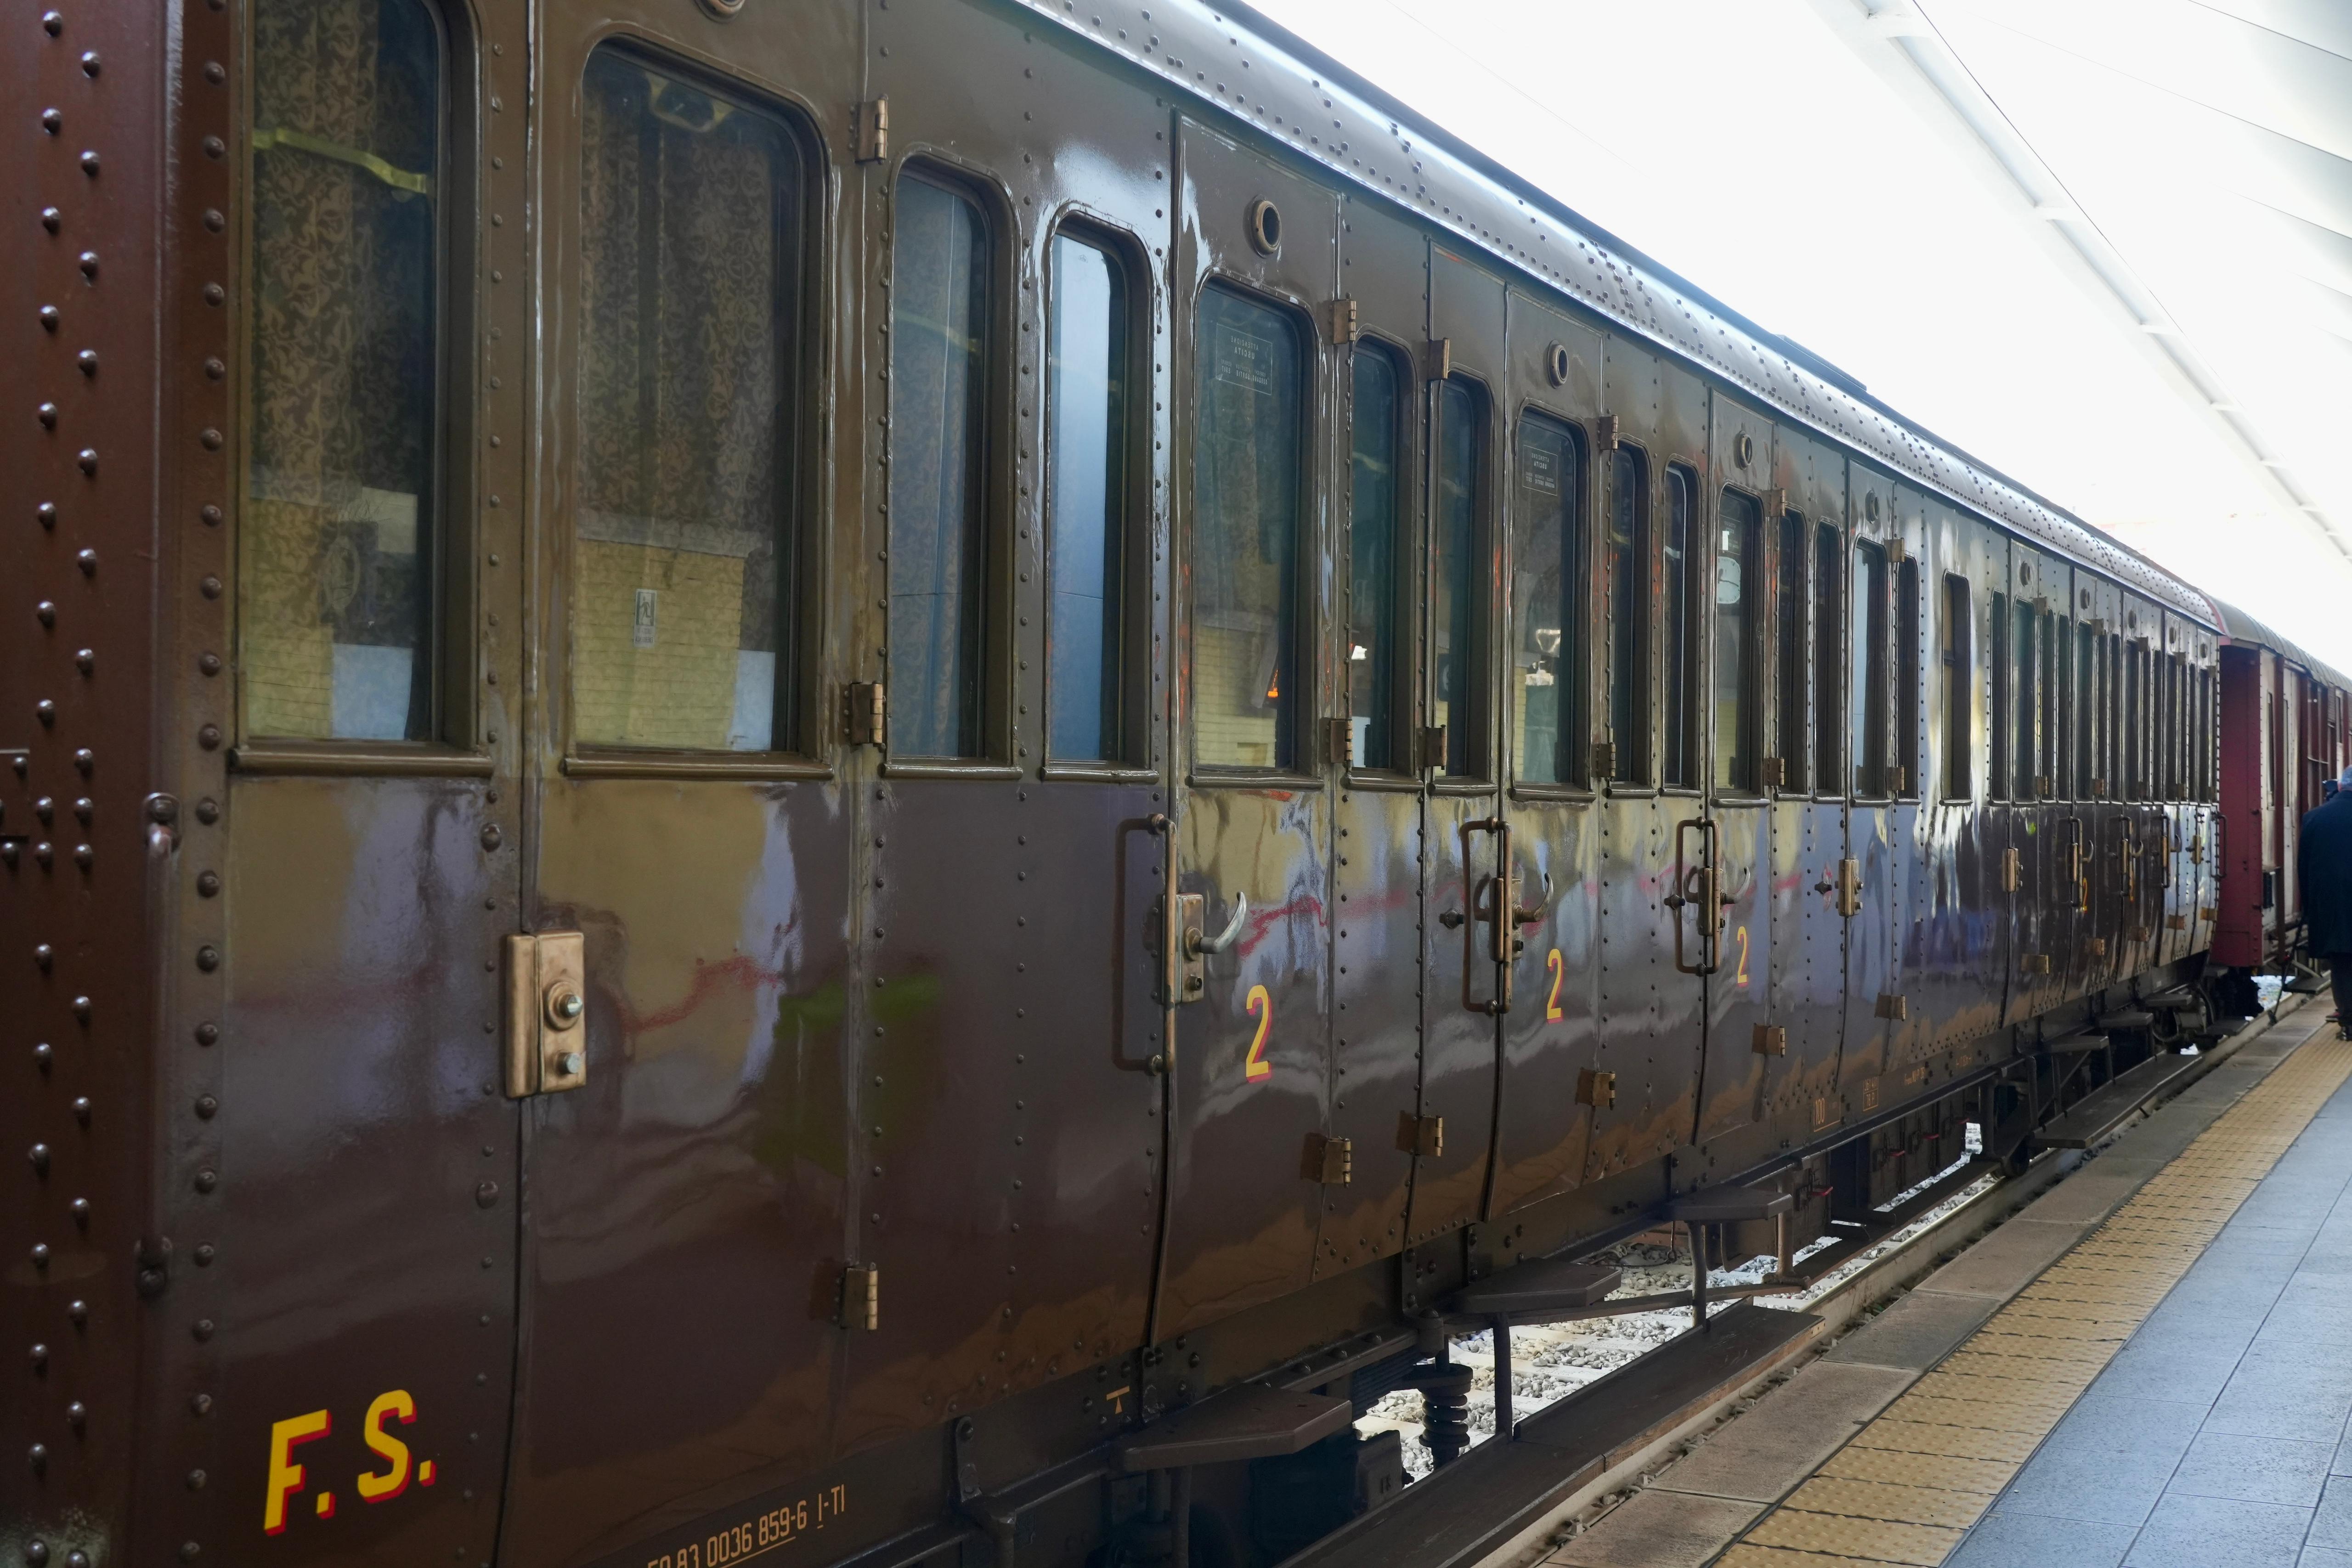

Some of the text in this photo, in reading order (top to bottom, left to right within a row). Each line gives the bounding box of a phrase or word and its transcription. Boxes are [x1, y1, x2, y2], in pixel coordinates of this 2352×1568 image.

[1547, 948, 1563, 1024] 2
[1737, 926, 1748, 987] 2
[1246, 985, 1272, 1083] 2
[1815, 1098, 1825, 1124] 100
[707, 1522, 752, 1567] 0036
[758, 1500, 807, 1545] 859-6
